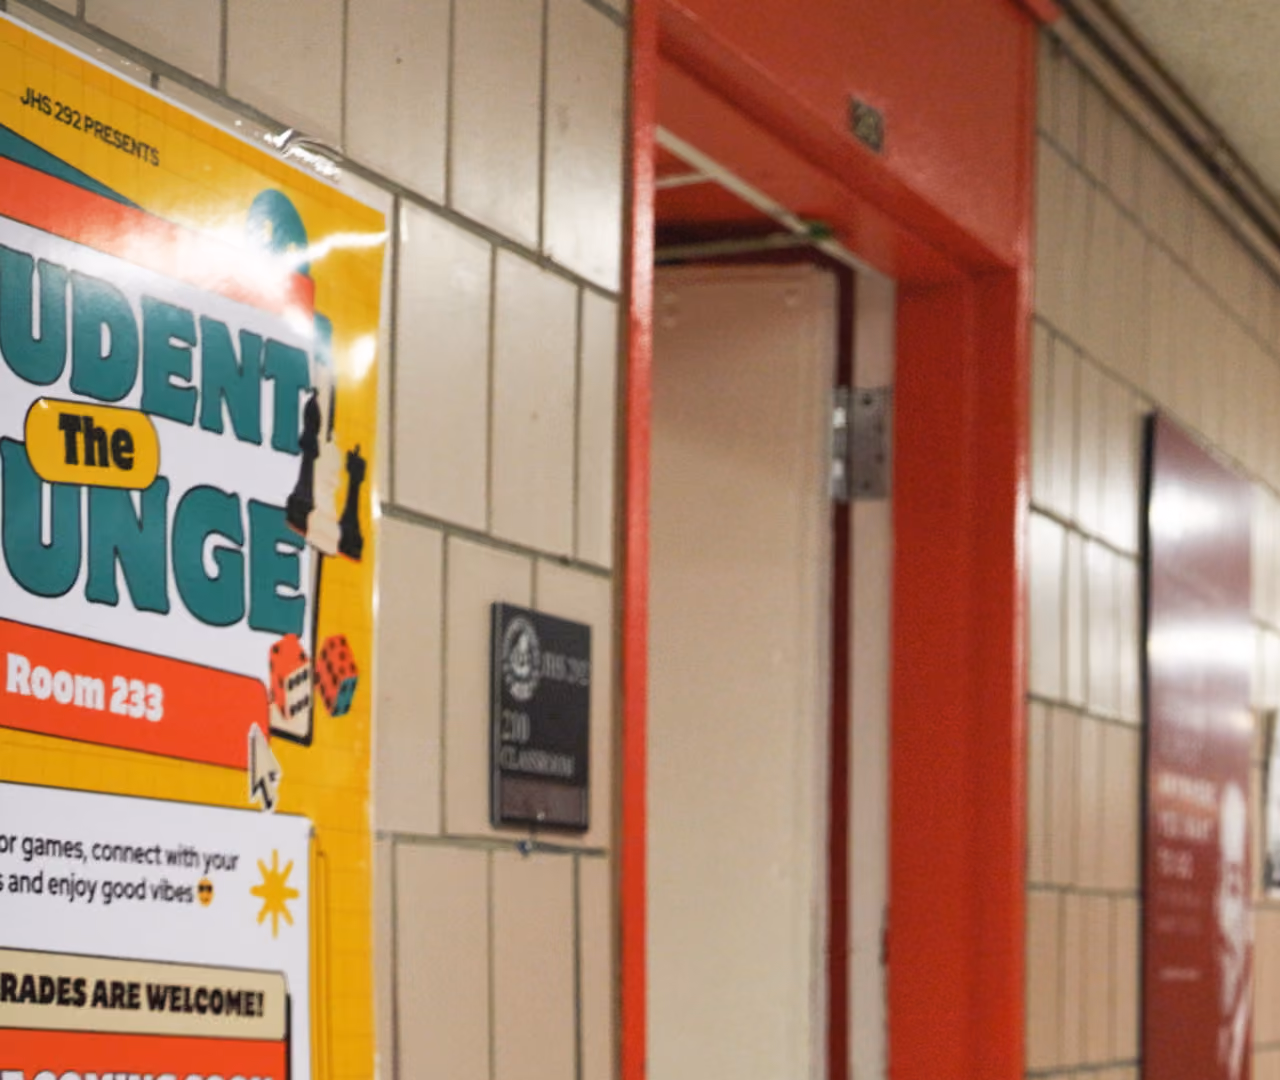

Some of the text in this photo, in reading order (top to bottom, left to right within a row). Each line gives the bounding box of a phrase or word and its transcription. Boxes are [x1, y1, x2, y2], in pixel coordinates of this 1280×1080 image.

[20, 86, 161, 167] JHS 292 PRESENTS
[57, 411, 135, 471] The
[6, 652, 164, 722] Room 233
[21, 836, 88, 863] games,
[91, 841, 162, 866] connect
[164, 844, 201, 869] with
[202, 853, 240, 875] your
[8, 870, 44, 894] and
[47, 872, 98, 904] enjoy
[101, 878, 147, 905] good
[149, 879, 195, 904] vibes
[0, 971, 265, 1019] RADES ARE WELCOME!
